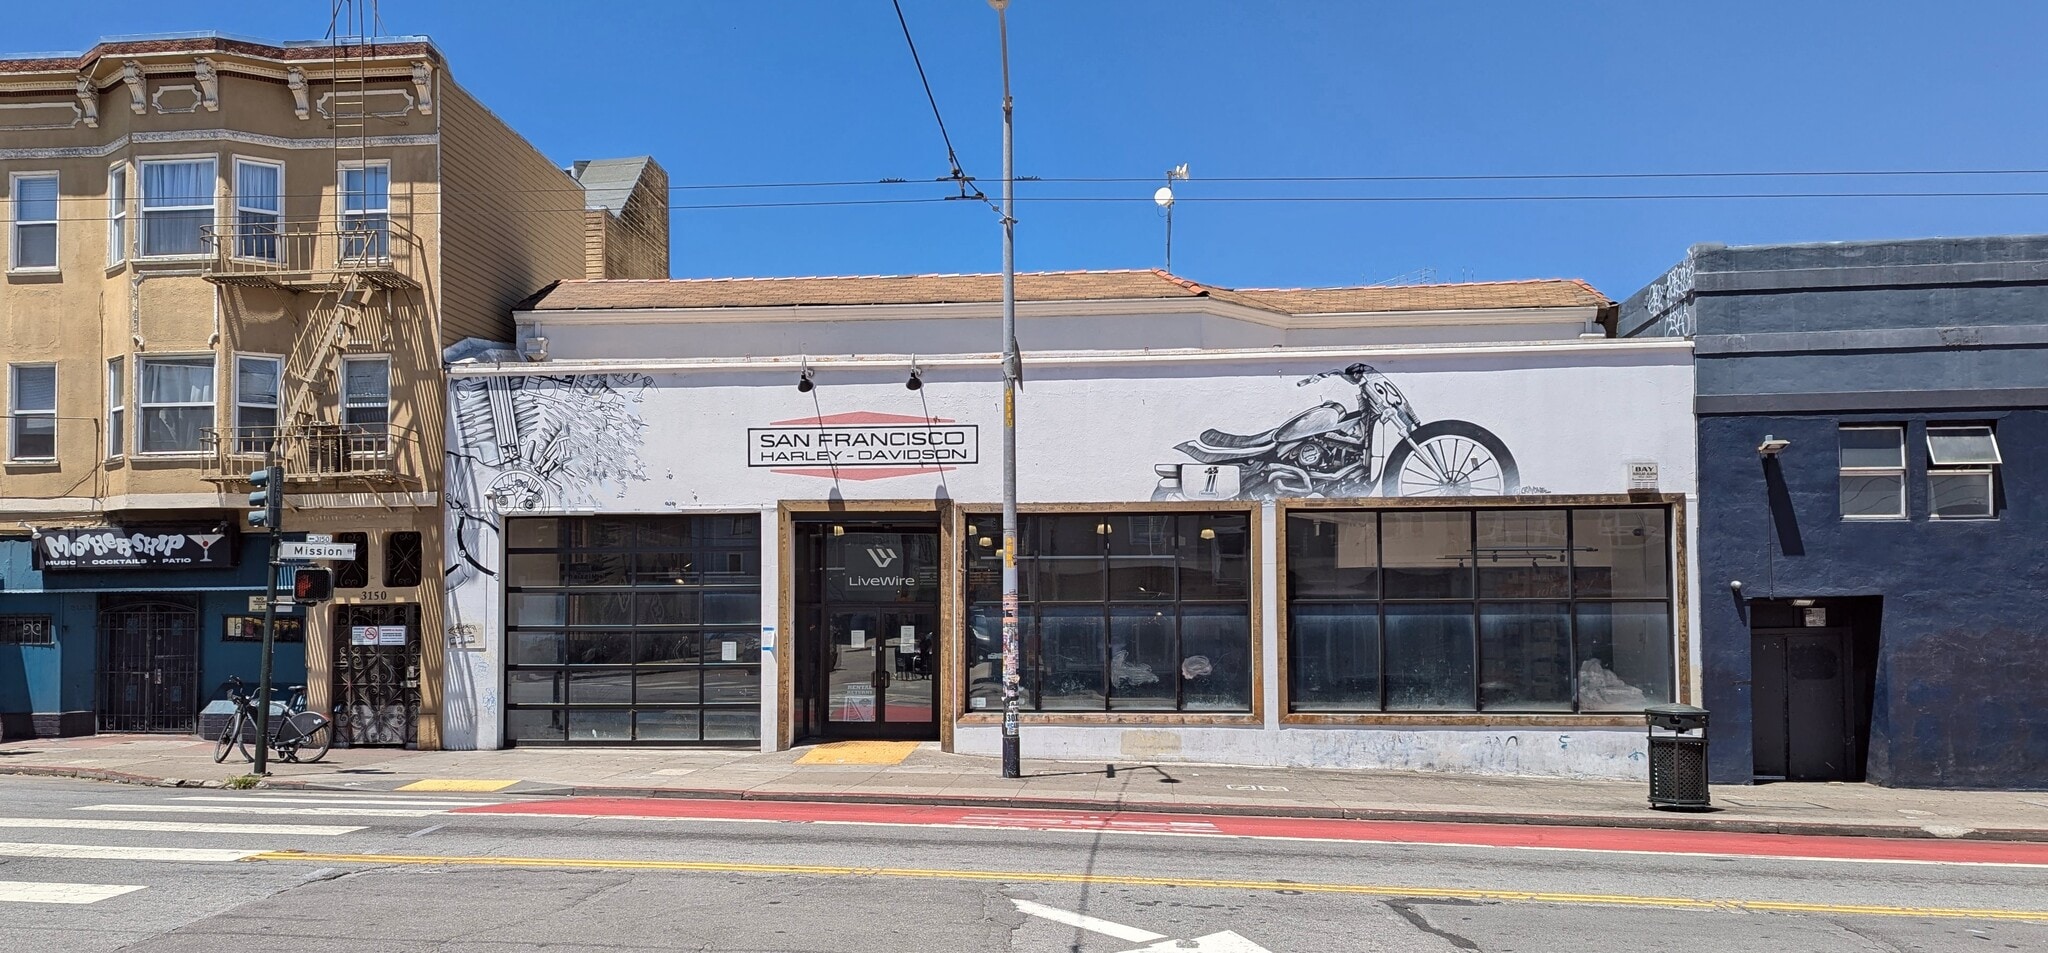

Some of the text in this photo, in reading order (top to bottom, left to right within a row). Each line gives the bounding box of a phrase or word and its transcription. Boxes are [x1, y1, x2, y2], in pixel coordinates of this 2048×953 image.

[760, 431, 965, 448] SAN FRANCISCO
[760, 451, 843, 462] HARLEY
[858, 449, 967, 461] DAVIDSON
[294, 546, 342, 556] Mission
[849, 575, 915, 586] LiveWire
[361, 591, 387, 600] 3150
